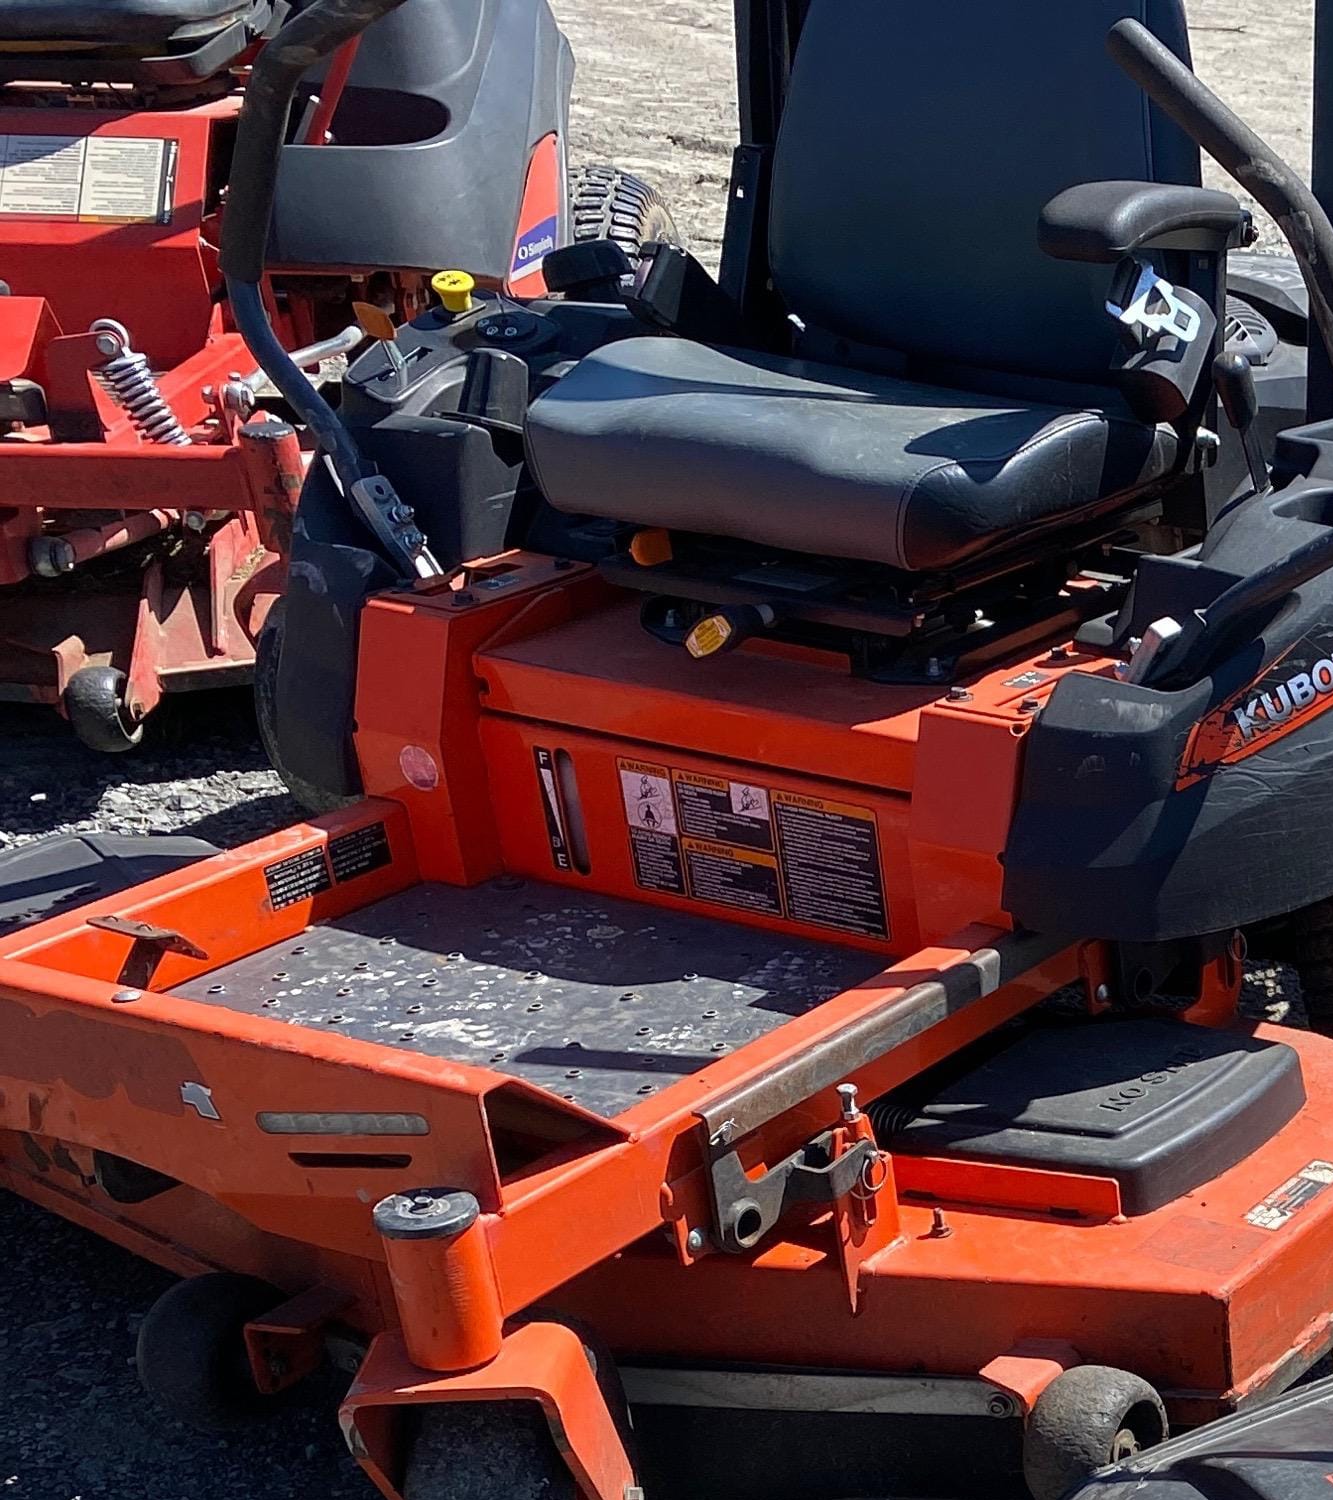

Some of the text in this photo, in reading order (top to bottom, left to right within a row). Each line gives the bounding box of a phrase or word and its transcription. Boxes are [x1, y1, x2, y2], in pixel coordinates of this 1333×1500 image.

[538, 751, 548, 765] F
[627, 762, 667, 778] WARNING
[686, 774, 724, 788] WARNING
[783, 794, 824, 809] WARNING
[695, 843, 734, 857] WARNING
[557, 854, 568, 867] E
